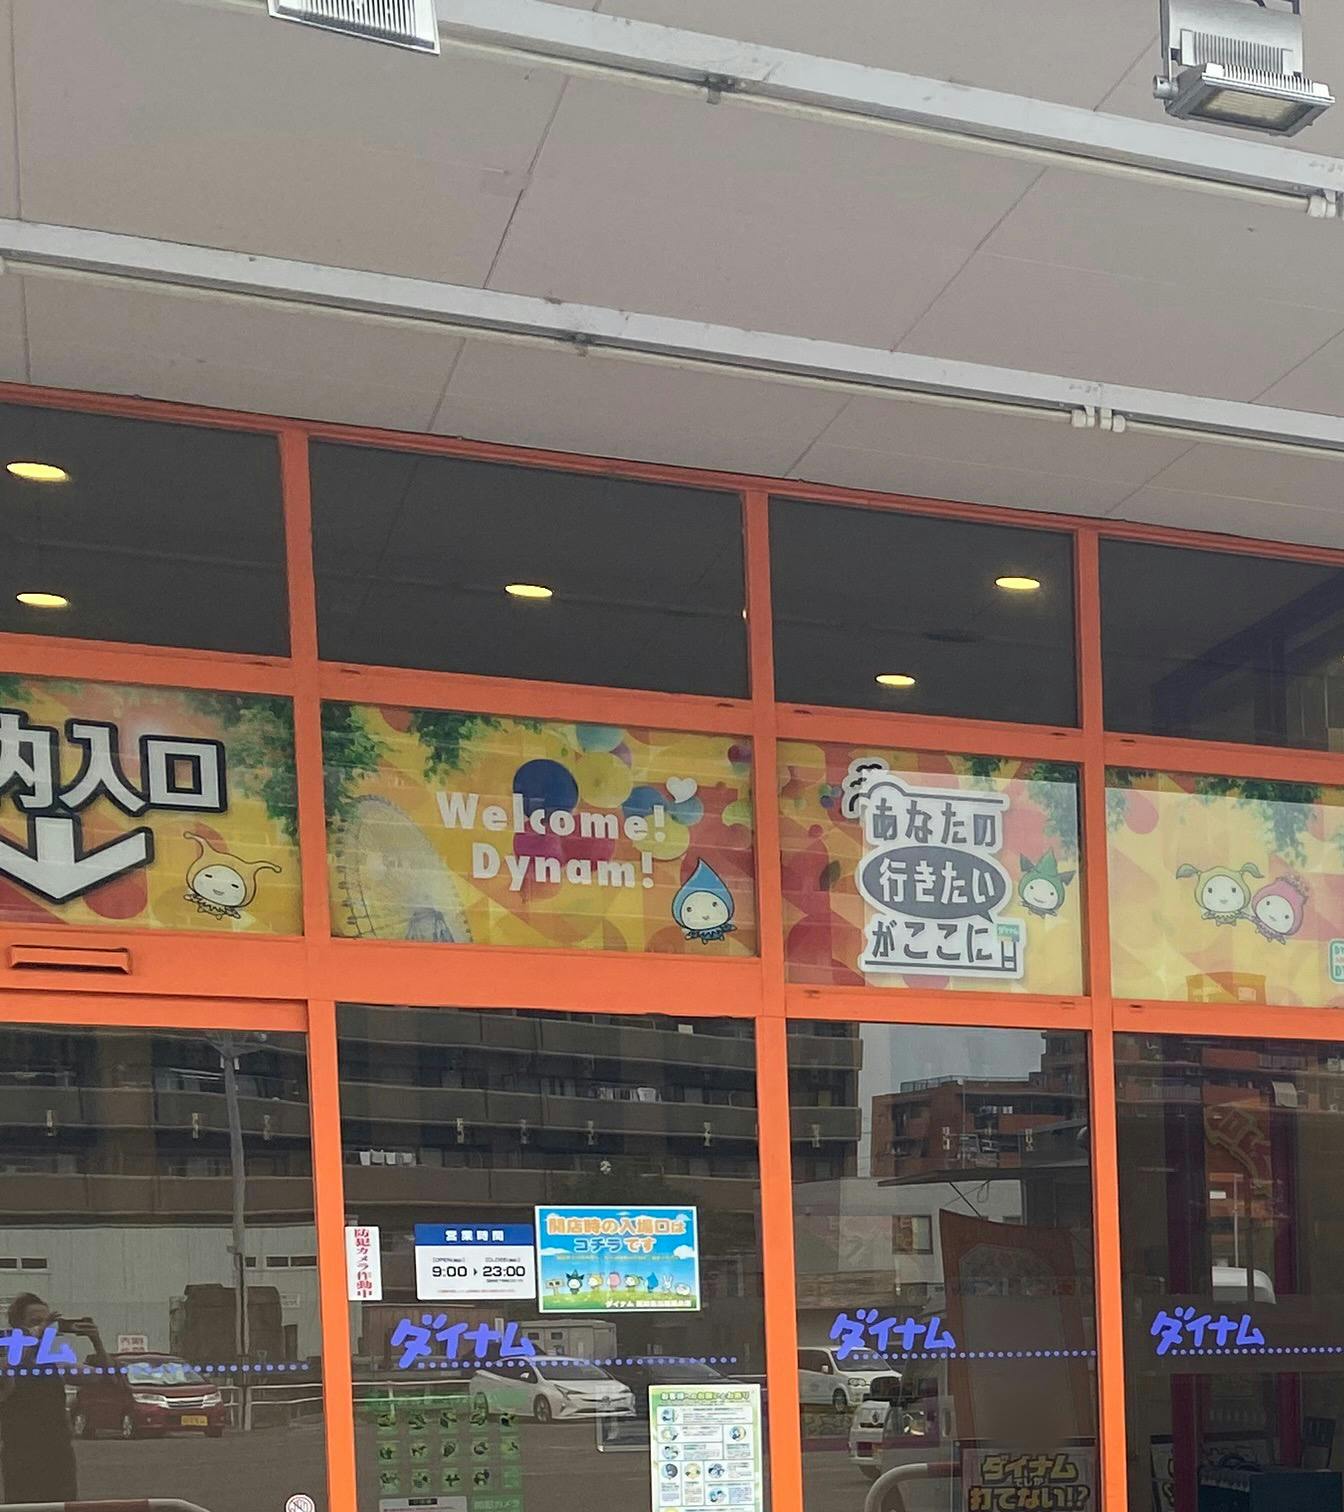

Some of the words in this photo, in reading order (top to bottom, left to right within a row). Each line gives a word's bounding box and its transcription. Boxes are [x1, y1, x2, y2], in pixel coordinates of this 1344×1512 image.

[0, 708, 227, 816] 内入口
[436, 791, 666, 842] Welcome!
[872, 797, 996, 847] あなたの
[472, 842, 655, 891] Dynam!
[879, 857, 994, 904] 行きたい
[872, 919, 993, 963] がここに
[574, 1236, 656, 1253] コチラです
[432, 1265, 468, 1277] 9:00
[482, 1265, 526, 1277] 23:00
[0, 1322, 78, 1366] ナム
[390, 1312, 536, 1369] ダイナム
[829, 1308, 957, 1361] ダイナム
[1150, 1306, 1266, 1356] ダイナム
[981, 1454, 1078, 1483] ダイナム
